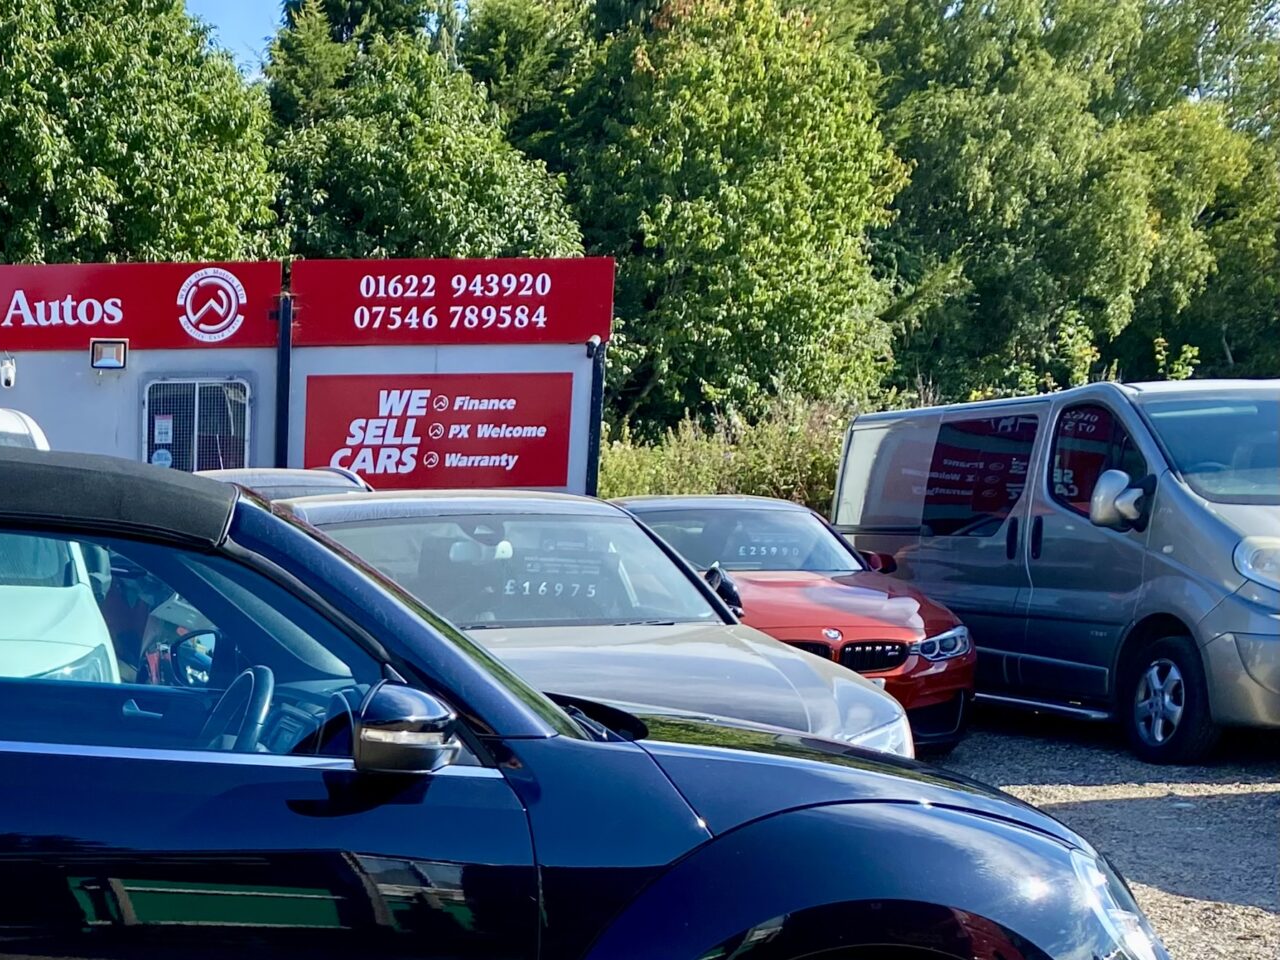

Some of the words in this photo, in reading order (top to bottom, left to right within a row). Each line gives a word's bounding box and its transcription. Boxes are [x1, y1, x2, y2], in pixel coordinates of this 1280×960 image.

[359, 274, 436, 298] 01622
[450, 272, 552, 297] 943920
[1, 290, 124, 327] Autos
[353, 305, 439, 330] 07546
[449, 304, 548, 329] 789584
[378, 389, 432, 416] WE
[452, 396, 517, 411] Finance
[346, 418, 422, 446] SELL
[447, 424, 471, 438] PX
[476, 423, 548, 438] Welcome
[329, 446, 419, 474] CARS
[444, 452, 519, 471] Warranty
[504, 579, 597, 598] £16975
